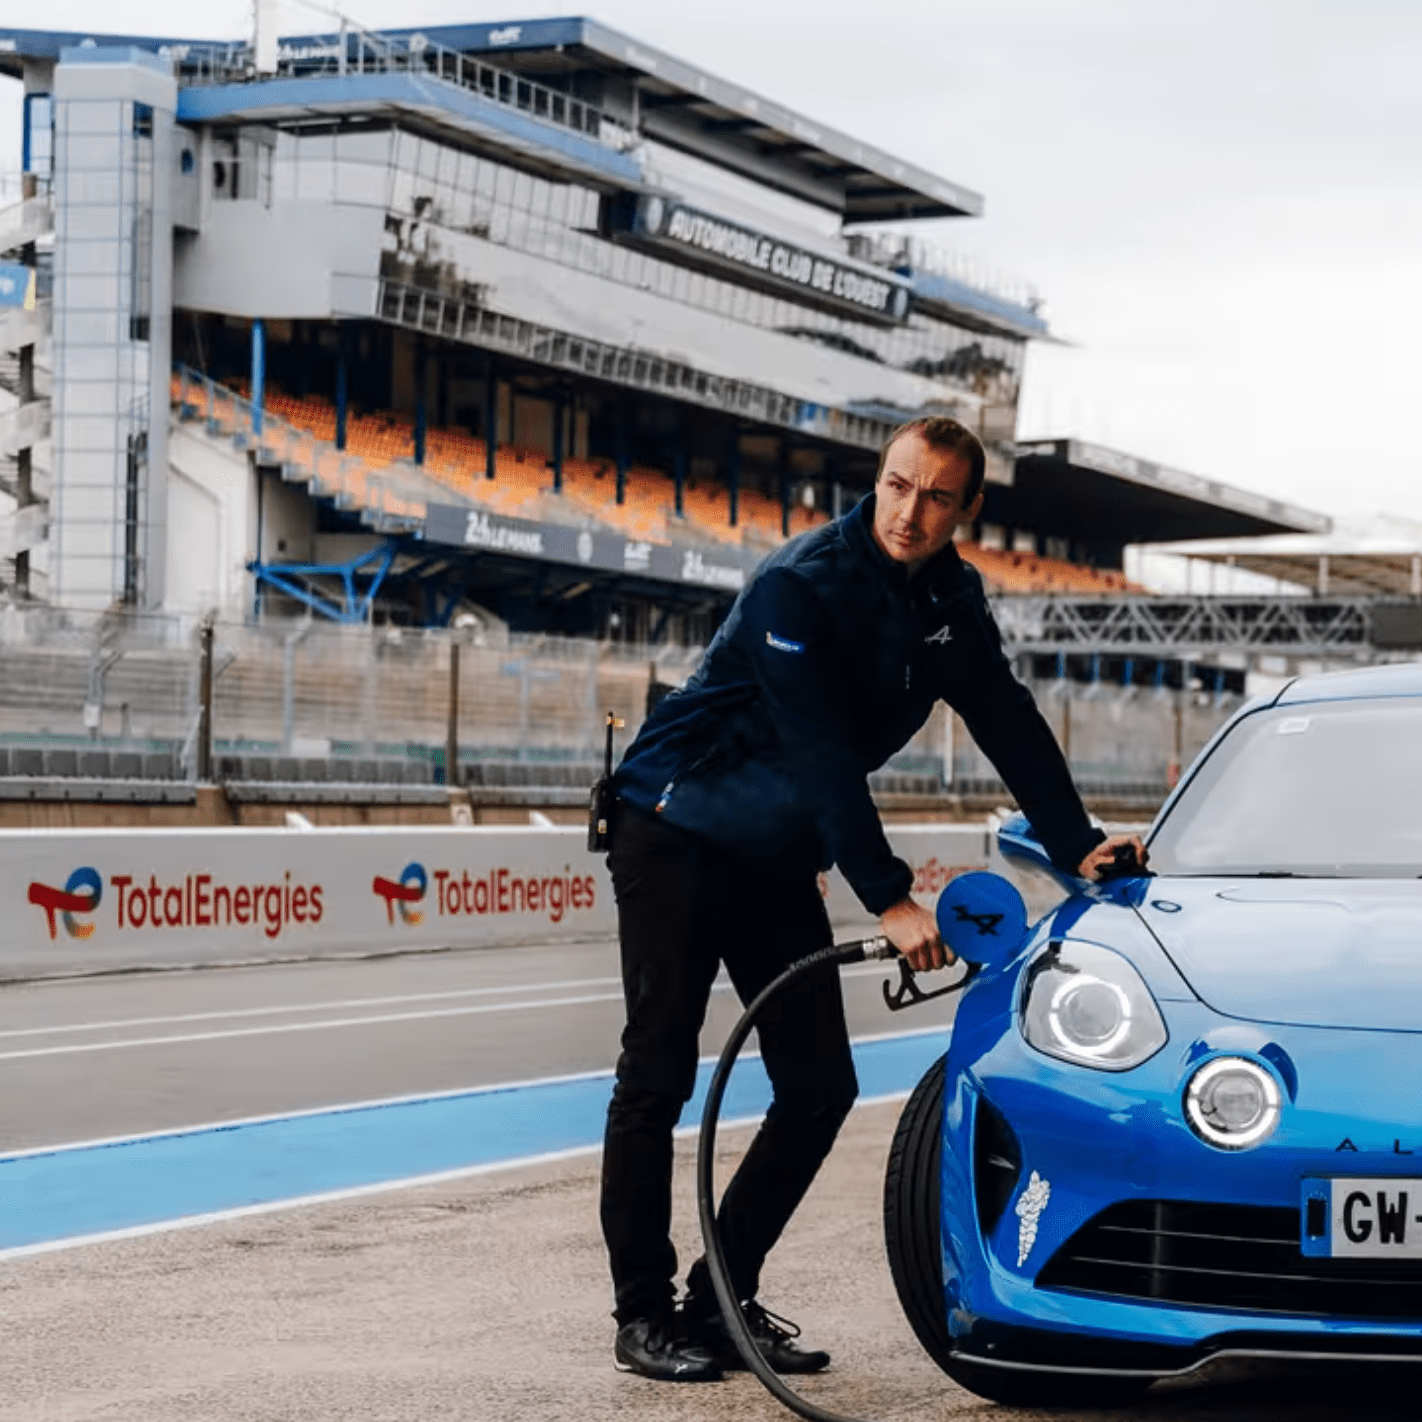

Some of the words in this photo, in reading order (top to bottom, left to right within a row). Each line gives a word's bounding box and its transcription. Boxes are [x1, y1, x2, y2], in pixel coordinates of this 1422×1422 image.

[669, 210, 772, 270] AUTOMOBILE
[771, 246, 812, 284] CLUB
[812, 261, 834, 292] DE
[834, 269, 891, 310] L'OUEST
[111, 870, 324, 939] TotalEnergies
[434, 864, 596, 923] TotalEnergies
